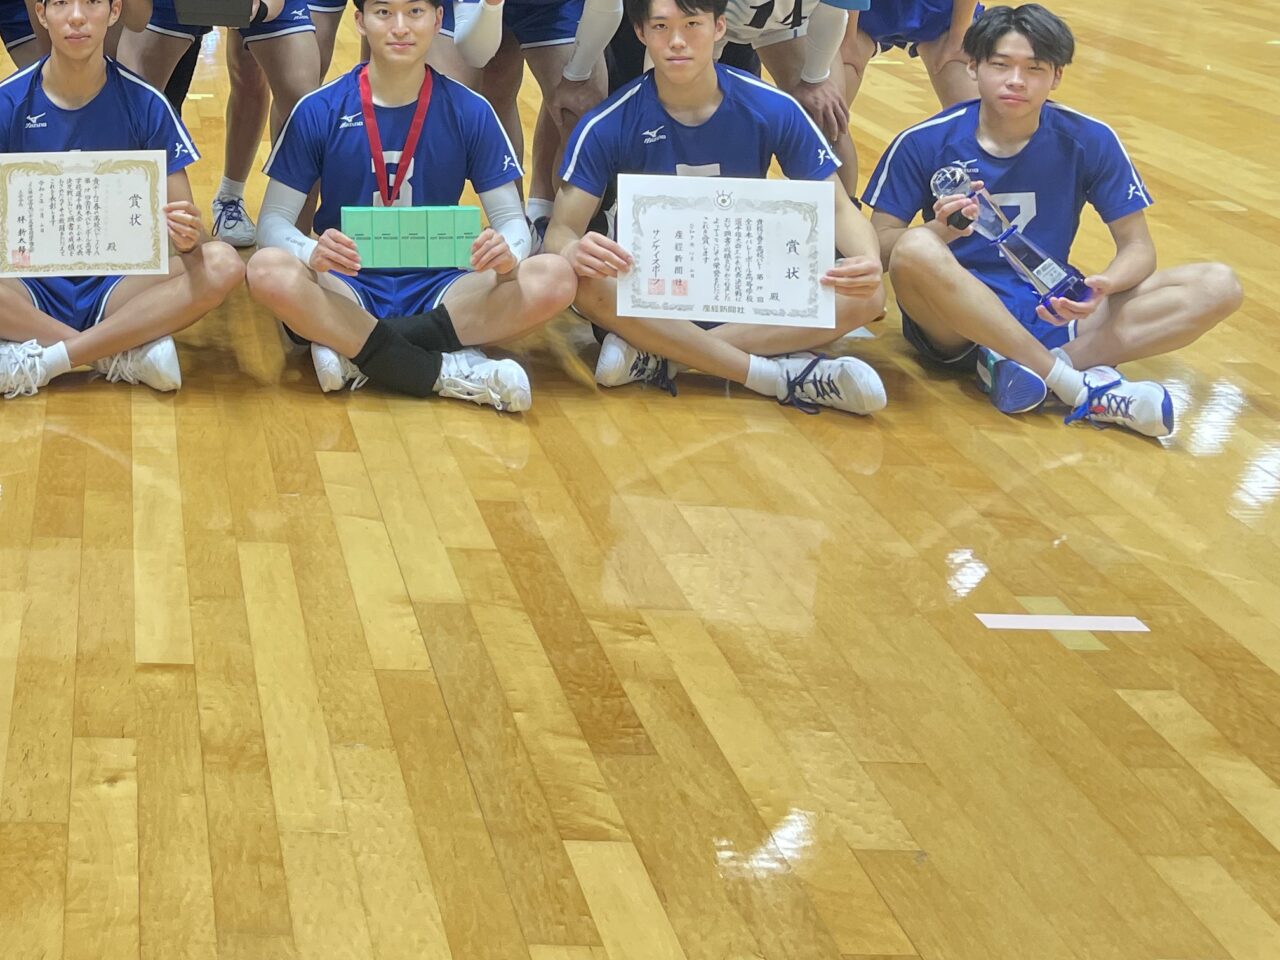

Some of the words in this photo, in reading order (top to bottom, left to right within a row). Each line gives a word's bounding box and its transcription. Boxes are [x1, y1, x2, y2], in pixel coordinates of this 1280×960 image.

[128, 193, 143, 227] 賞状
[674, 230, 683, 287] 産経新聞社
[785, 239, 801, 280] 賞状
